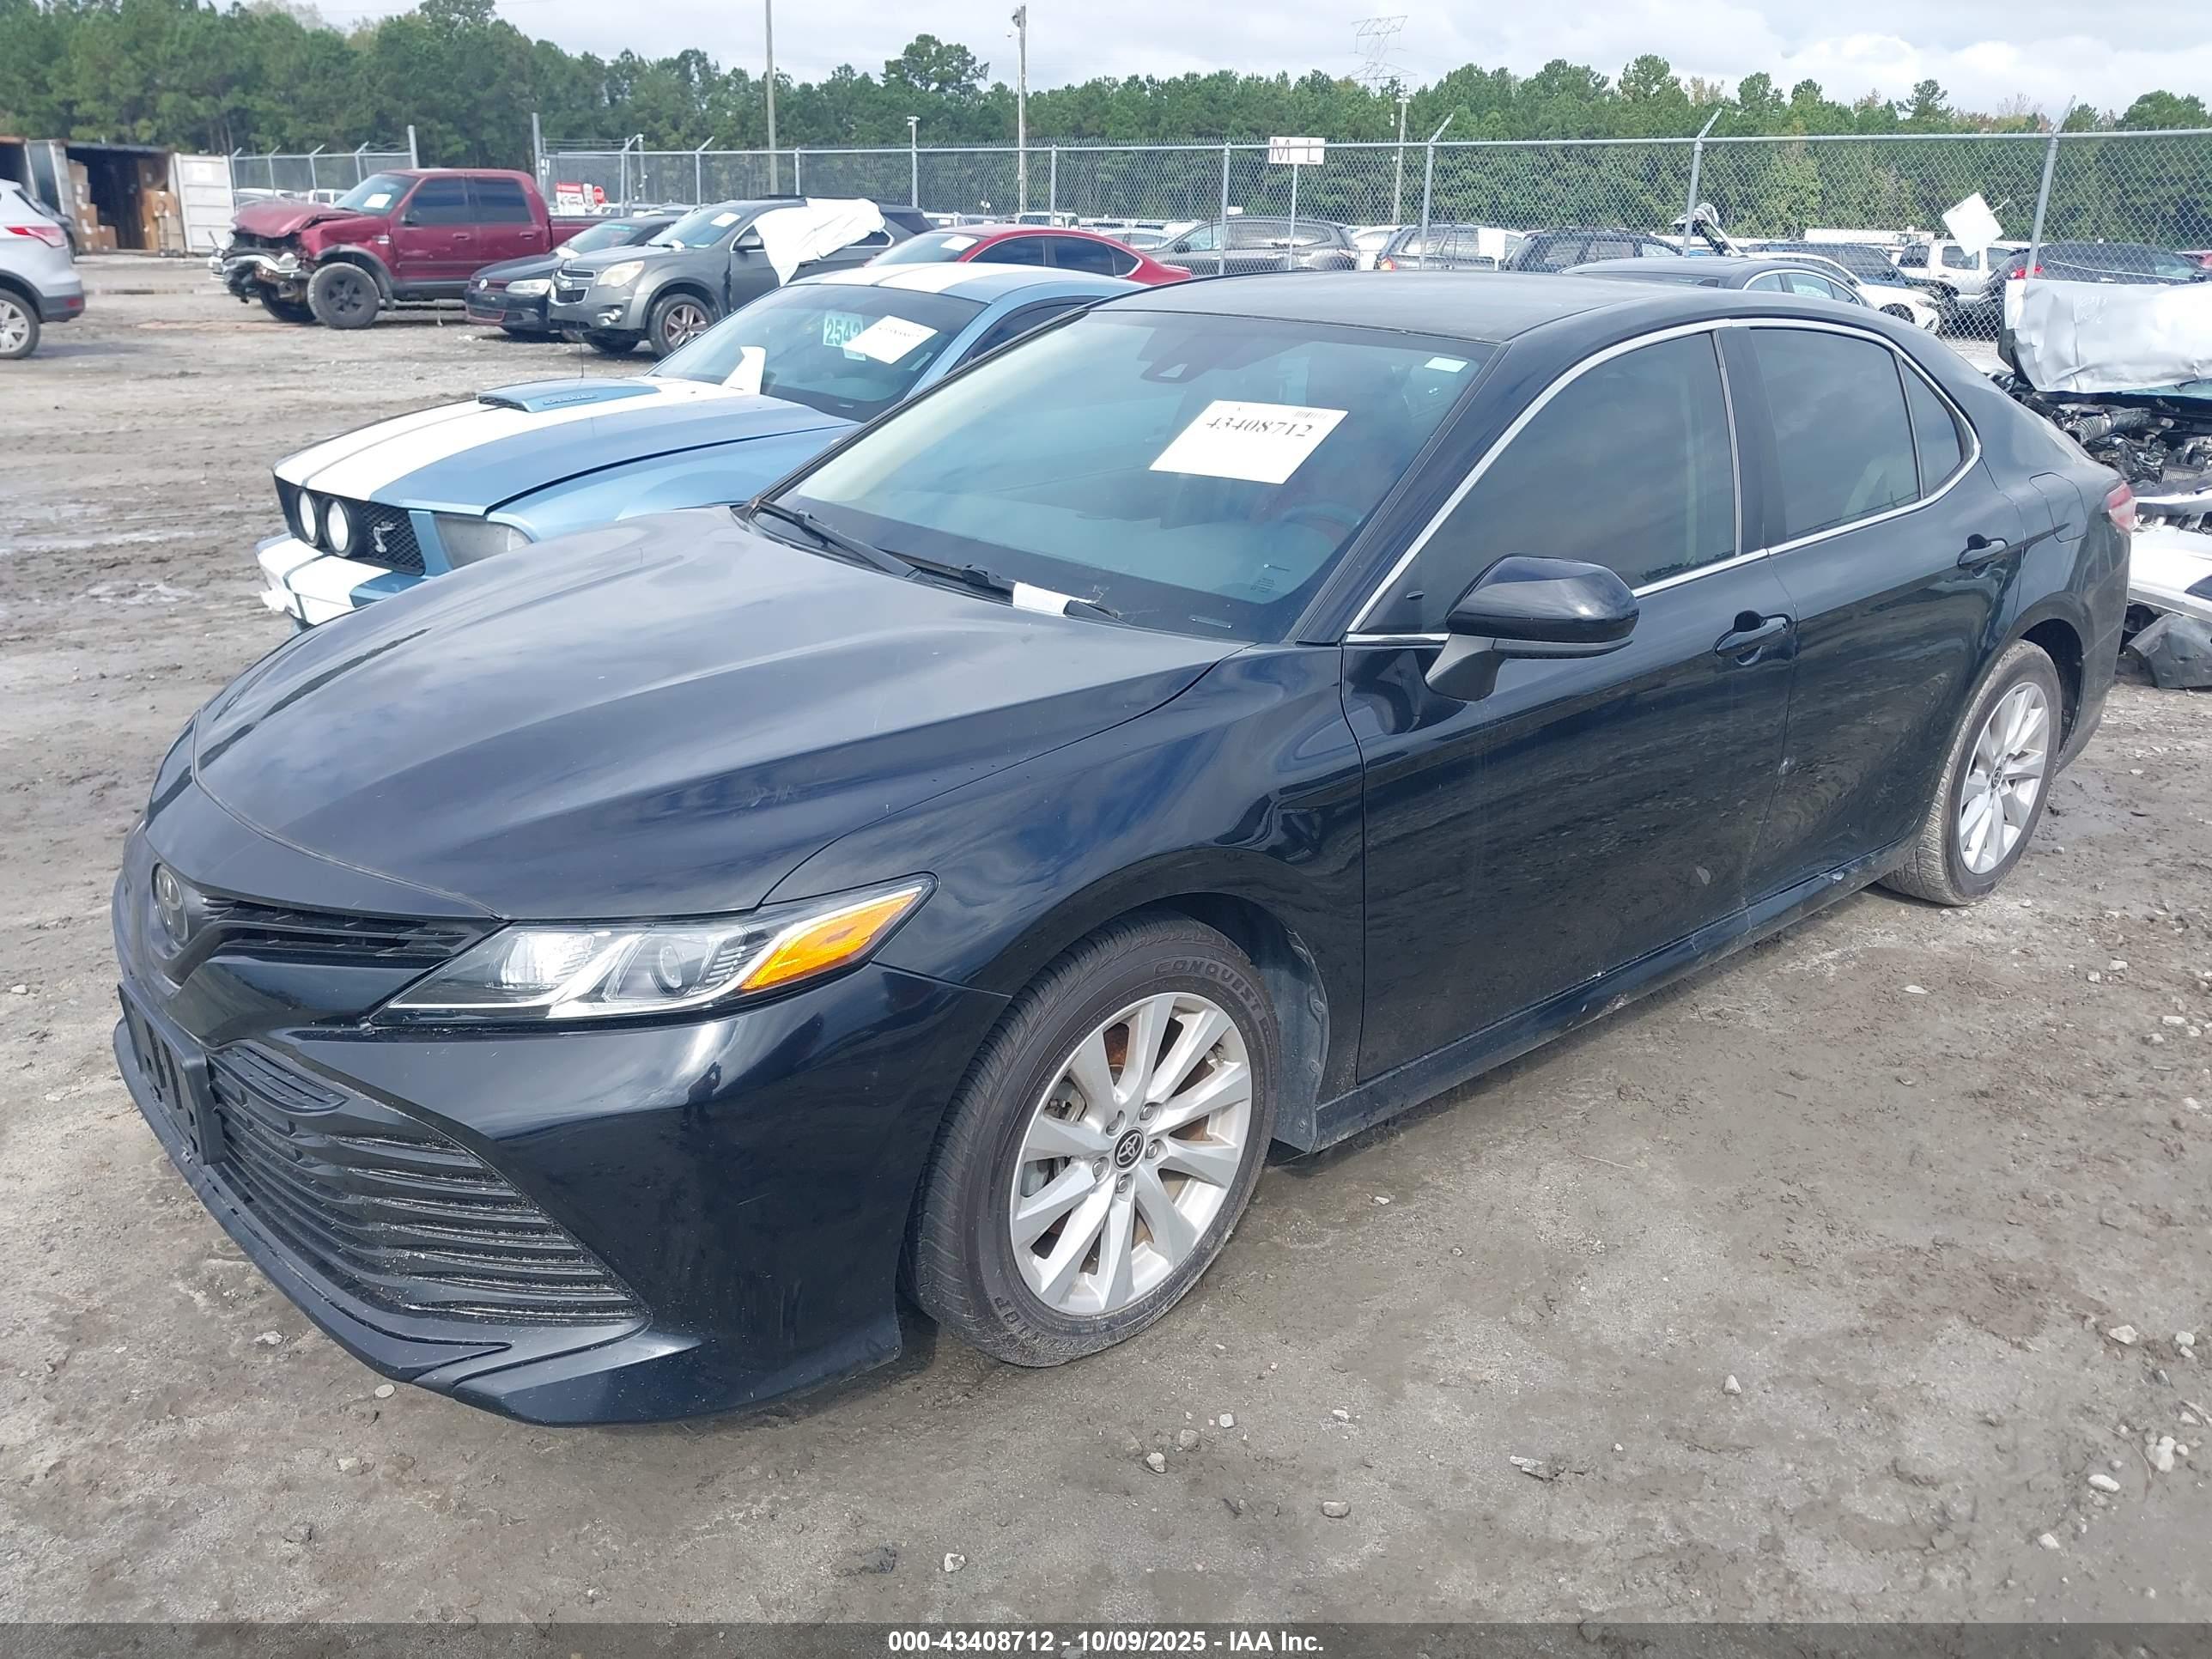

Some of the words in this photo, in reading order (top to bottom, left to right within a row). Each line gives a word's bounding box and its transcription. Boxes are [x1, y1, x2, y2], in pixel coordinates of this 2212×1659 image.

[1271, 138, 1291, 161] M
[1307, 139, 1318, 163] L
[1206, 416, 1314, 438] 43408712
[1154, 958, 1262, 1015] CONQUEST
